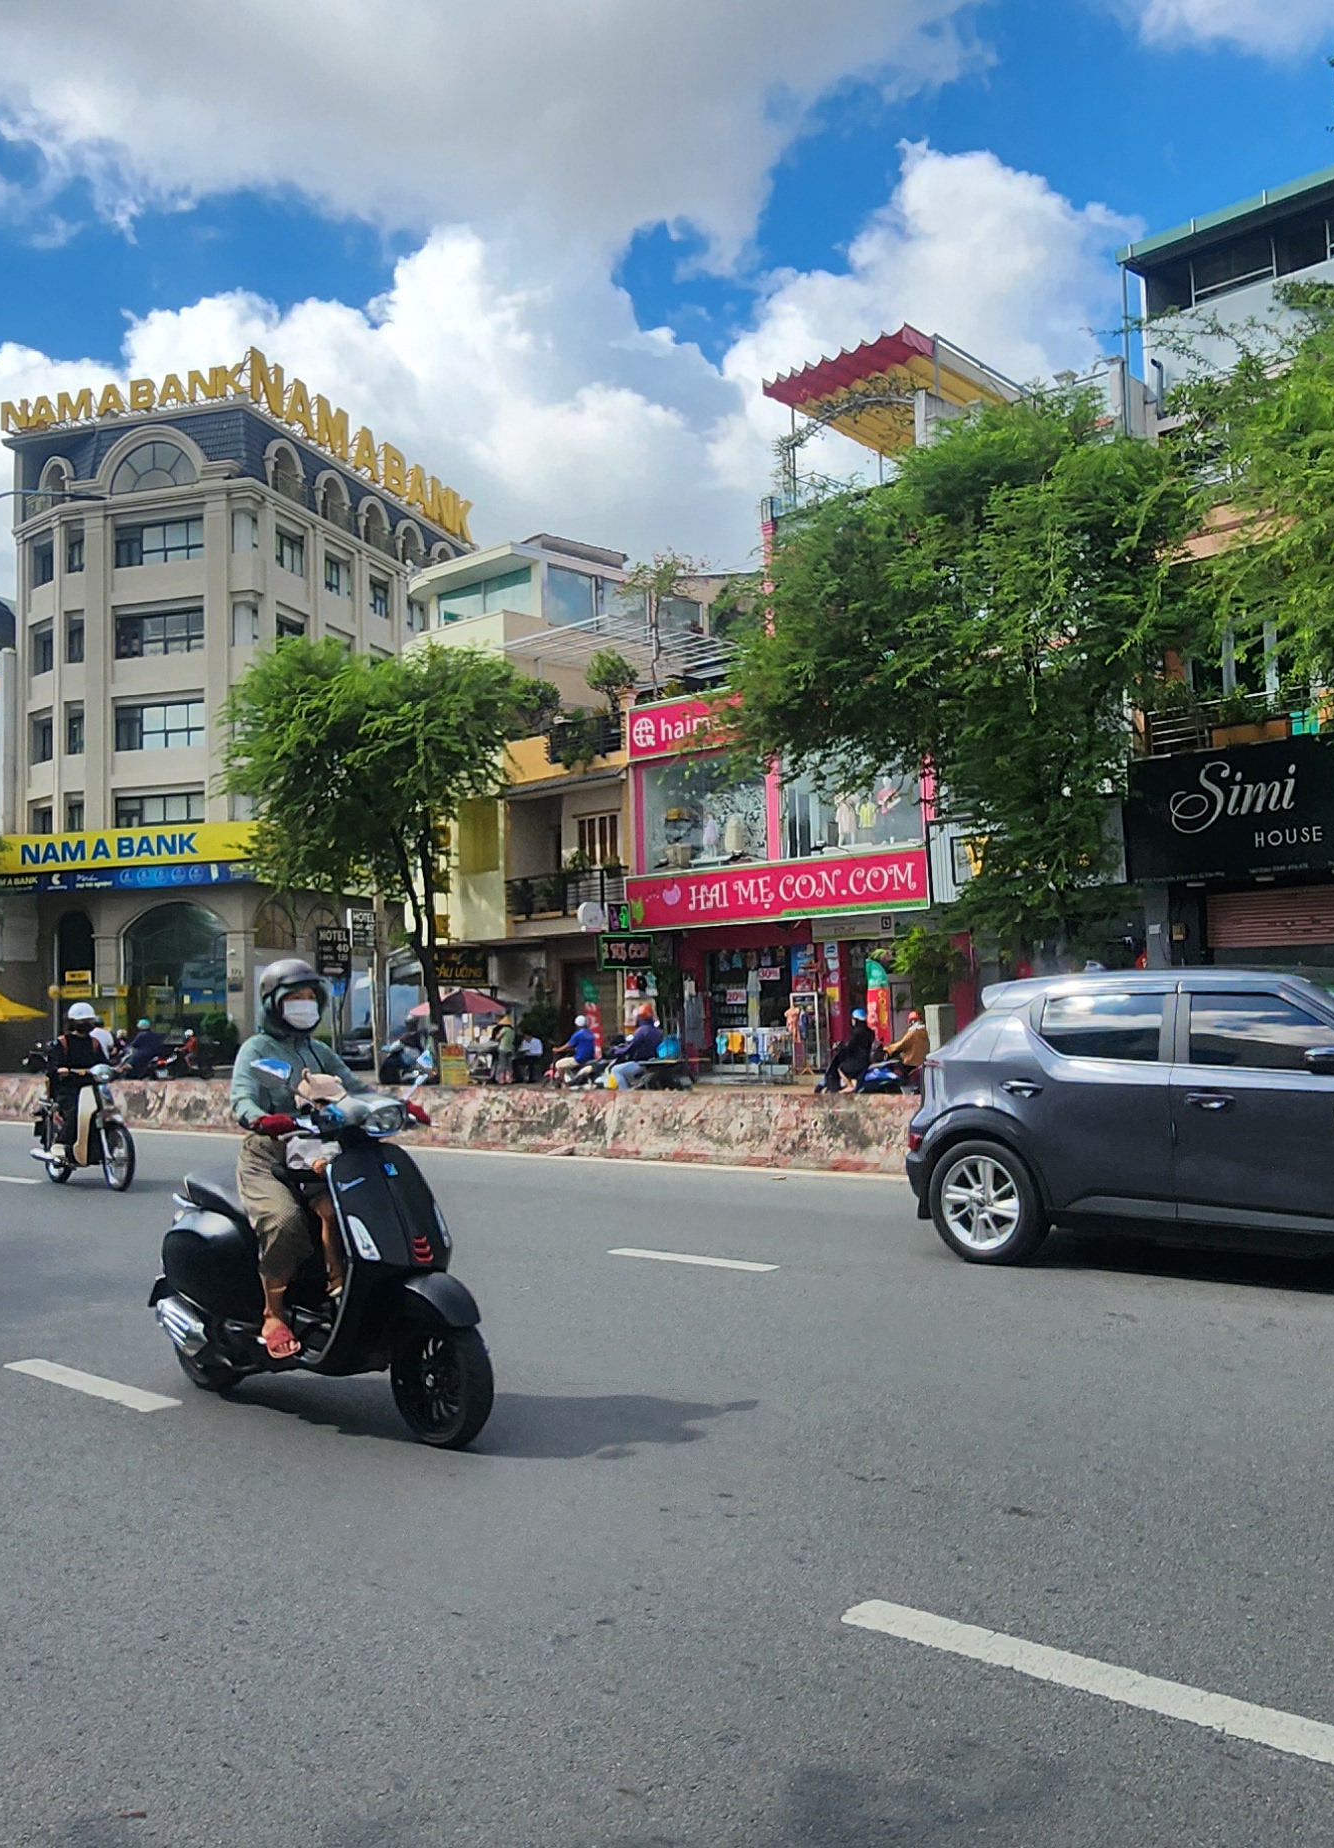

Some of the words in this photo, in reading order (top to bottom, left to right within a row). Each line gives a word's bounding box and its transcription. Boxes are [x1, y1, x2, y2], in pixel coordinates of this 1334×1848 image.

[1, 388, 93, 431] NAM
[98, 383, 125, 416] A
[130, 362, 246, 411] BANK
[250, 346, 350, 461] NAM
[354, 426, 380, 483] A
[383, 442, 474, 543] BANK
[1169, 761, 1297, 834] Simi
[20, 839, 86, 866] NAM
[91, 838, 111, 861] A
[116, 832, 199, 859] BANK
[1254, 825, 1323, 848] HOUSE
[688, 880, 730, 911] HAI
[779, 862, 917, 902] CON.COM
[353, 911, 376, 924] HOTEL
[318, 929, 348, 942] HOTEL
[336, 943, 349, 953] 40
[758, 968, 779, 979] 30%
